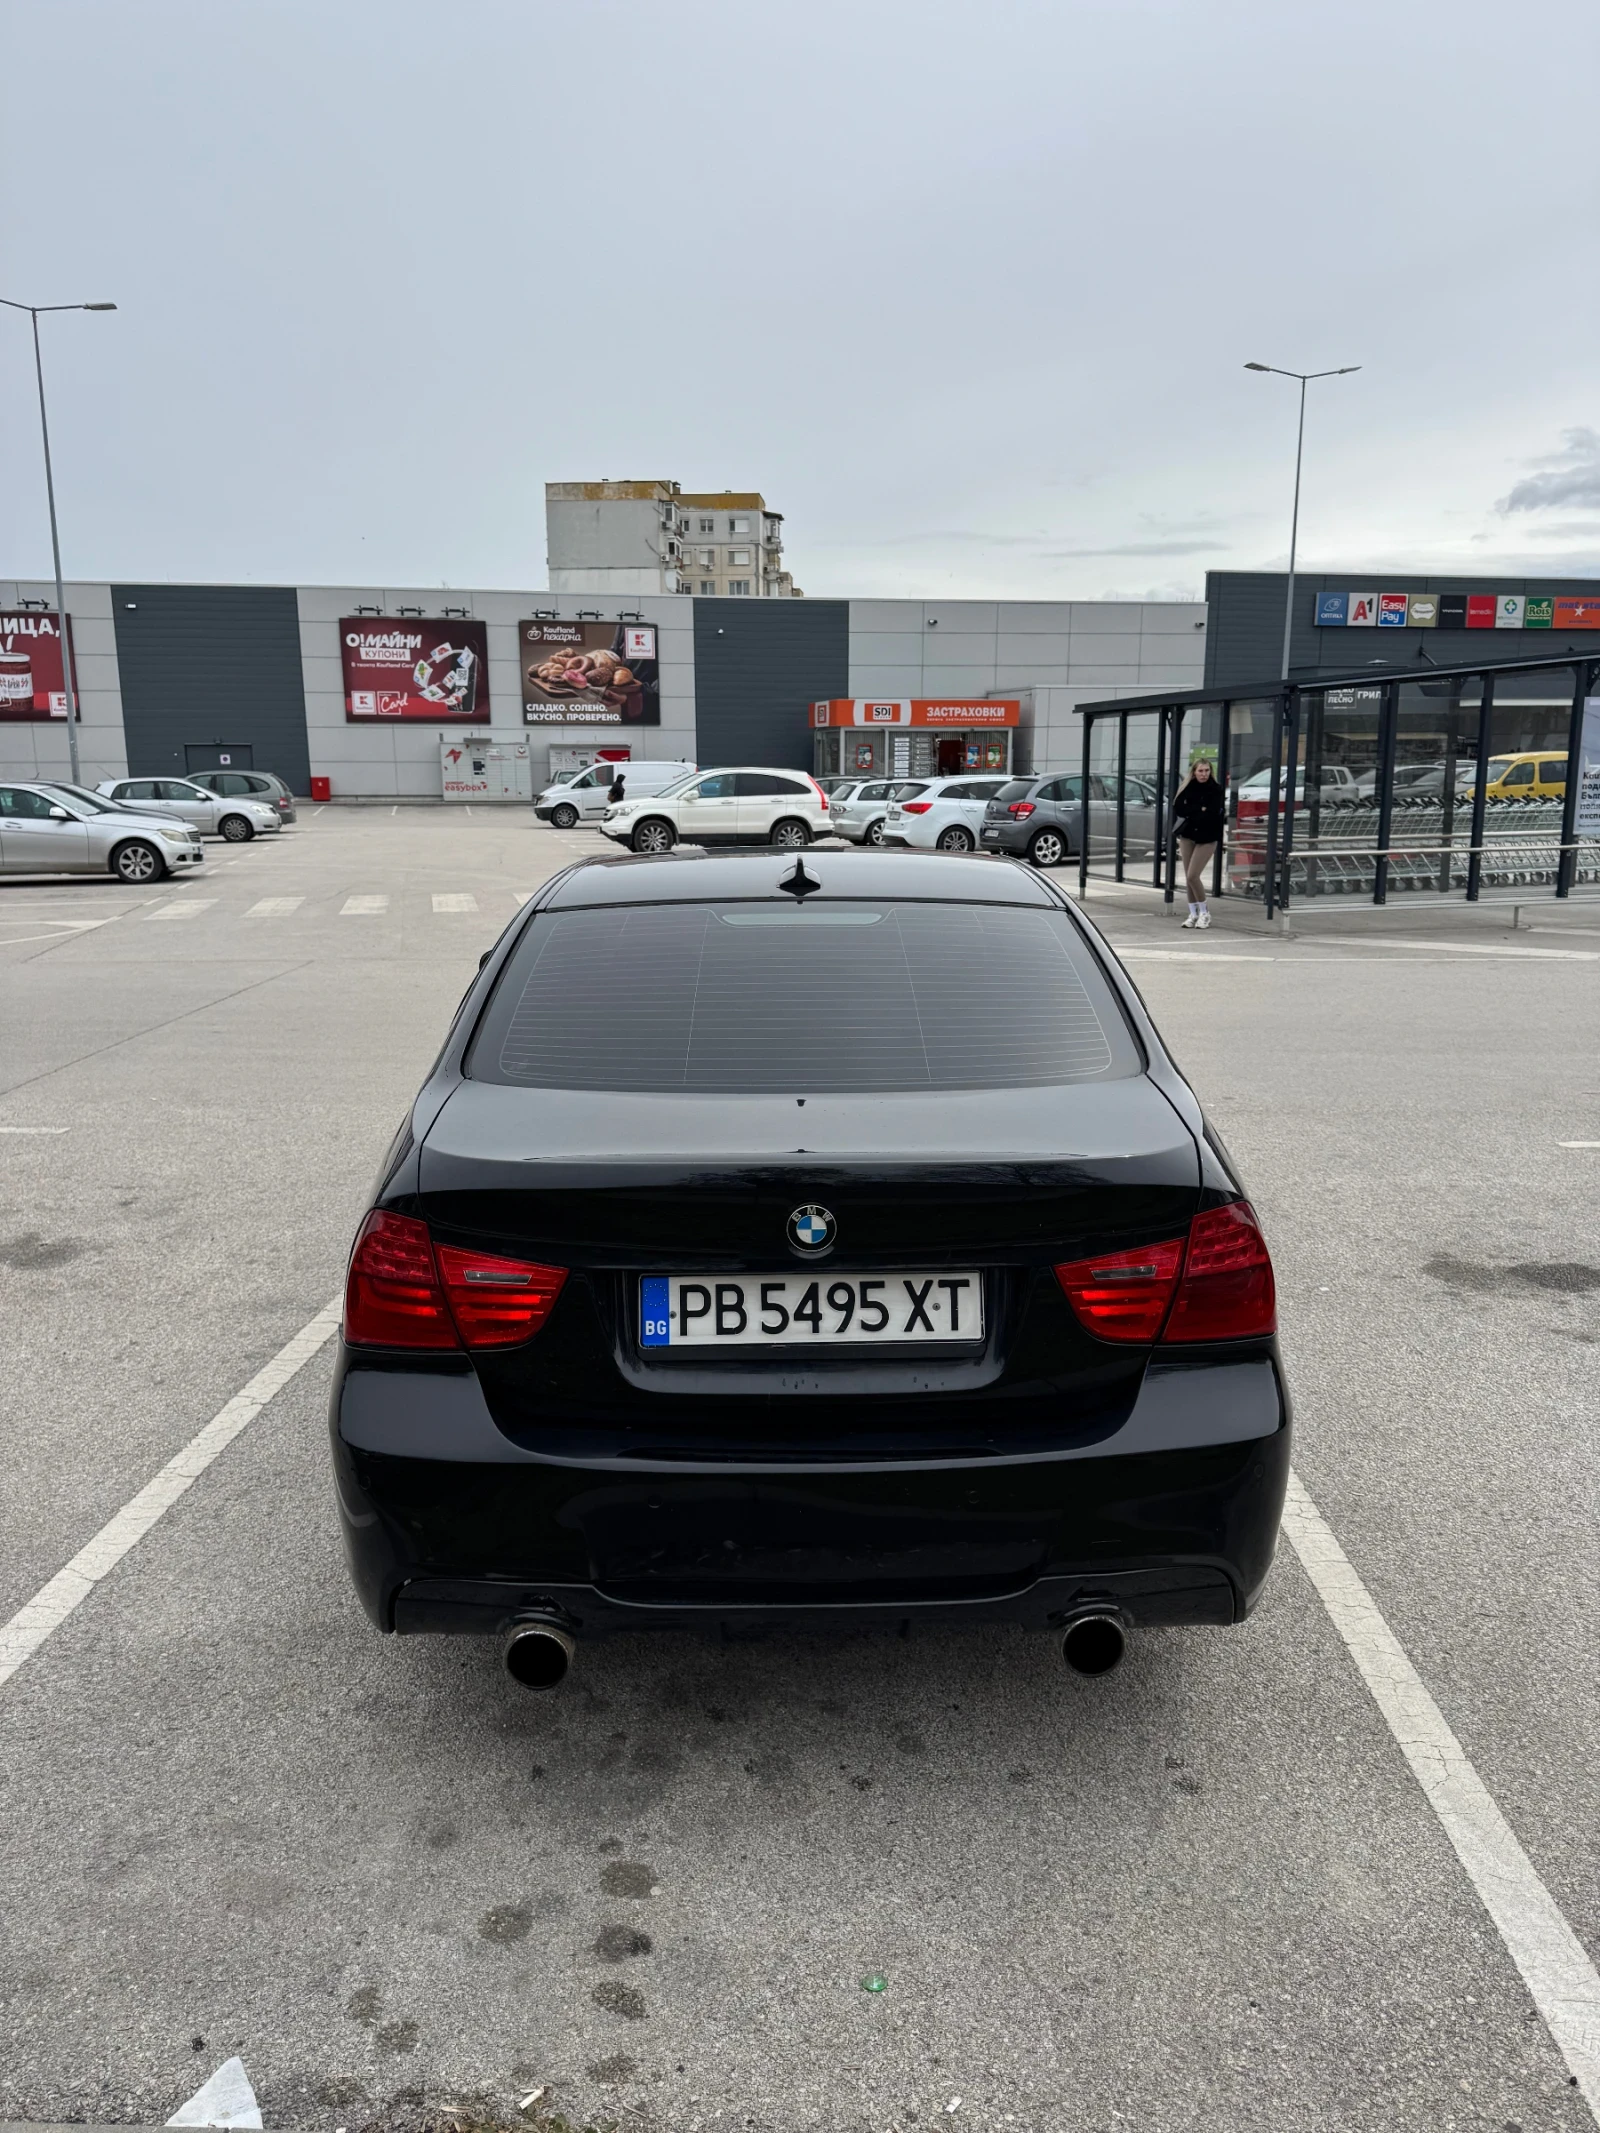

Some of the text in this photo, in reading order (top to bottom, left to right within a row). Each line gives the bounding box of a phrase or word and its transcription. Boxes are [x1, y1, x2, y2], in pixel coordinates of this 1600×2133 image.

[1352, 598, 1373, 621] A1
[1382, 600, 1405, 612] Easy
[1528, 605, 1551, 616] Rois
[1381, 611, 1400, 623] Pay
[0, 618, 60, 638] ИЦА,
[543, 626, 576, 634] Kaufland
[543, 634, 582, 642] пекарна
[365, 650, 406, 659] КУПОНИ
[1357, 690, 1382, 700] ГРИЛ
[381, 692, 408, 713] Card
[526, 703, 608, 712] СЛАДКО. СОЛЕНО.
[526, 713, 622, 721] ВКУСНО. ПРОВЕРЕНО.
[874, 707, 891, 717] SDI
[926, 706, 1005, 717] ЗАСТРАХОВКИ
[445, 784, 482, 792] easybox
[791, 1206, 833, 1222] BMW
[679, 1279, 970, 1336] PB 5495 XT
[645, 1320, 667, 1336] BG
